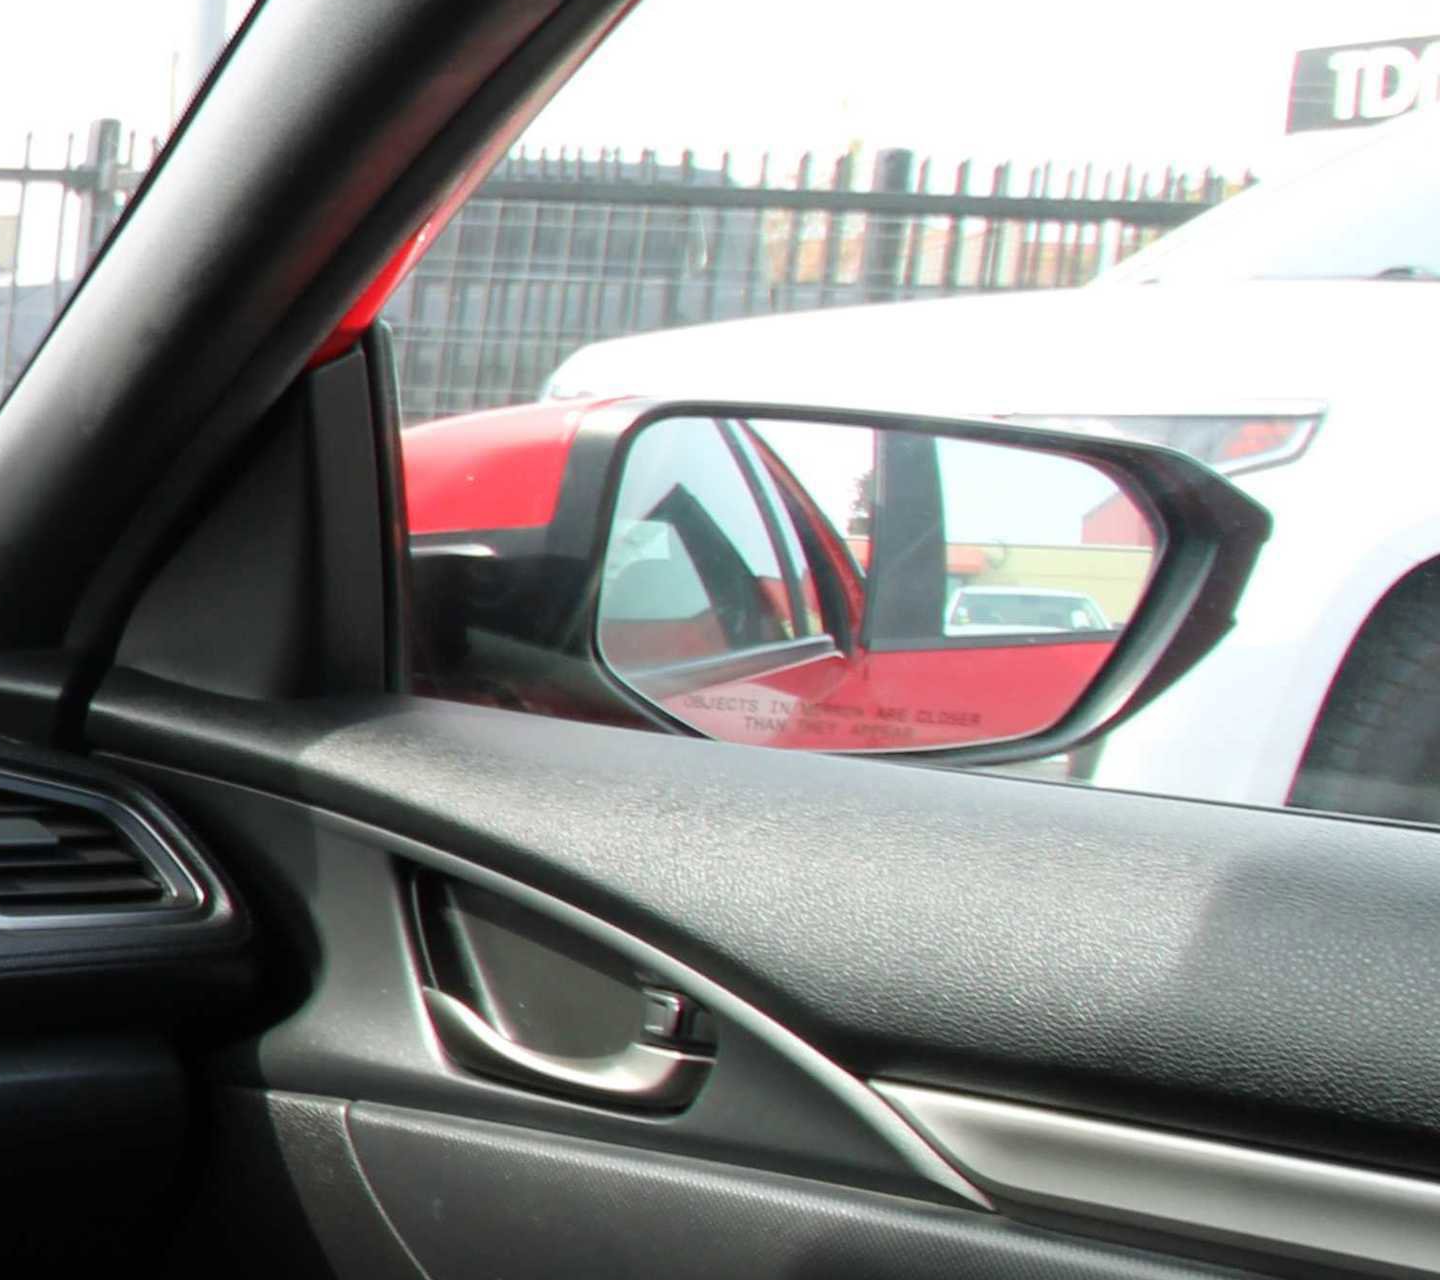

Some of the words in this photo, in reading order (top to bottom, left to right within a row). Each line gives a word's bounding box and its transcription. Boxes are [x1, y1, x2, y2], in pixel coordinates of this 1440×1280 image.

[683, 695, 759, 712] OBJECTS
[769, 699, 790, 715] IN
[877, 705, 908, 721] ARE
[915, 709, 981, 725] CLOSER
[745, 716, 786, 732] THAN
